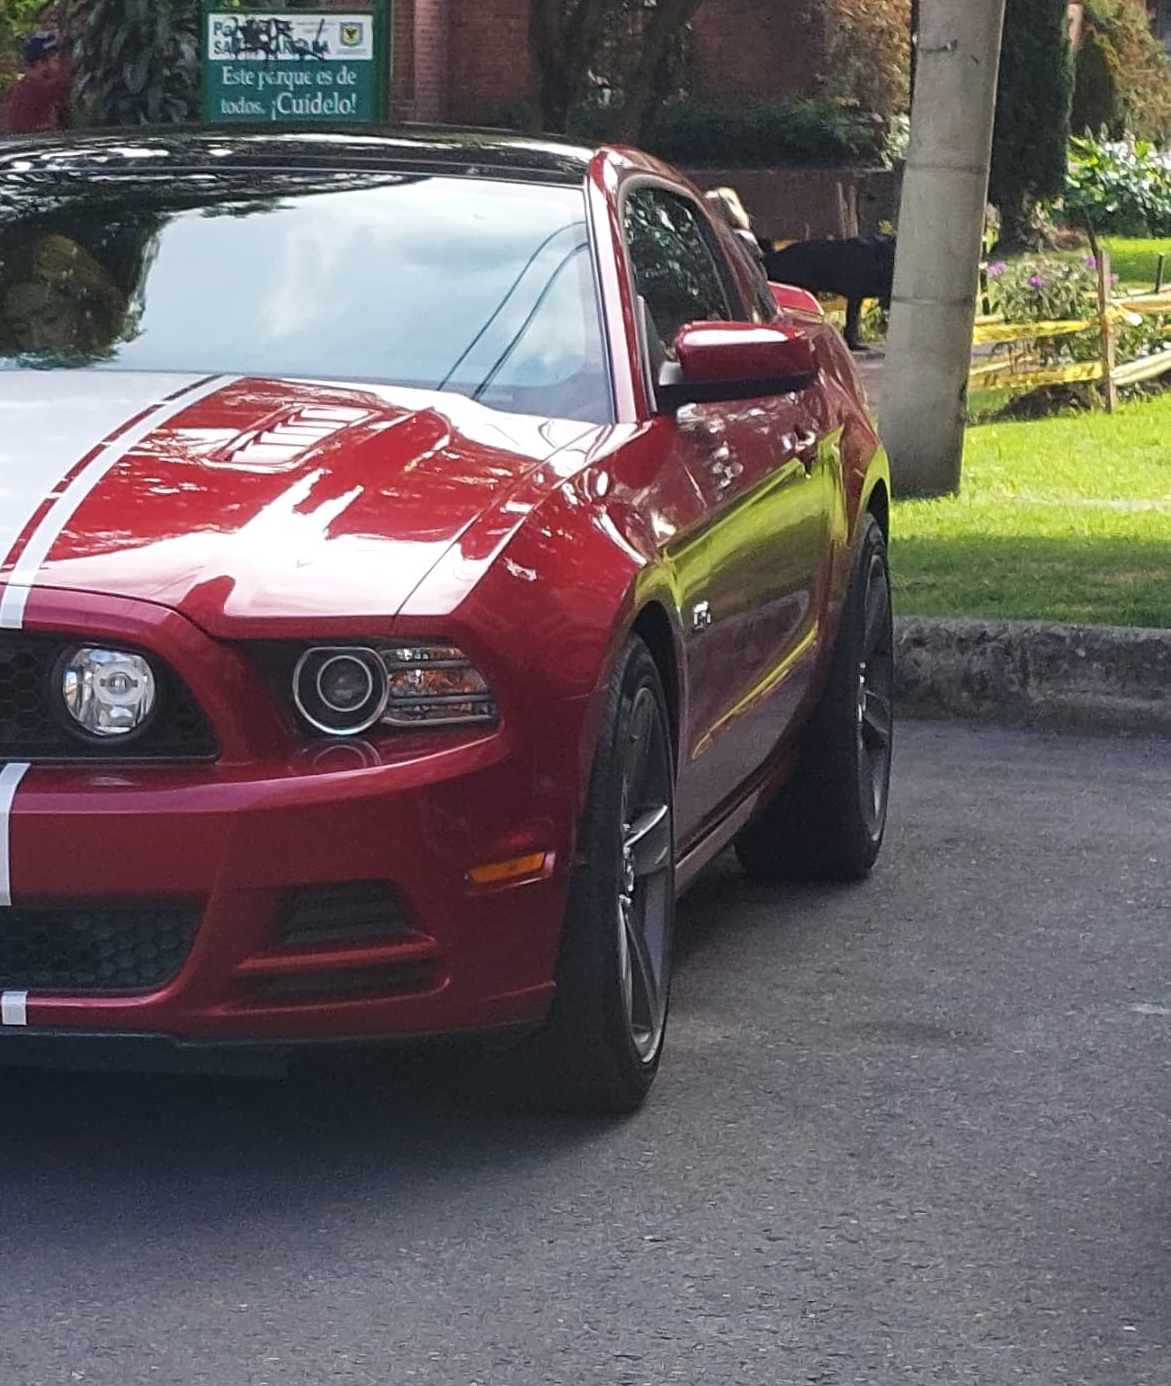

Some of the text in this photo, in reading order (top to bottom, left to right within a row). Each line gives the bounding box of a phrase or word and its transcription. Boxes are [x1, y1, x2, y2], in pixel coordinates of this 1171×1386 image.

[221, 65, 357, 91] Este parque es de
[221, 97, 266, 115] todos.
